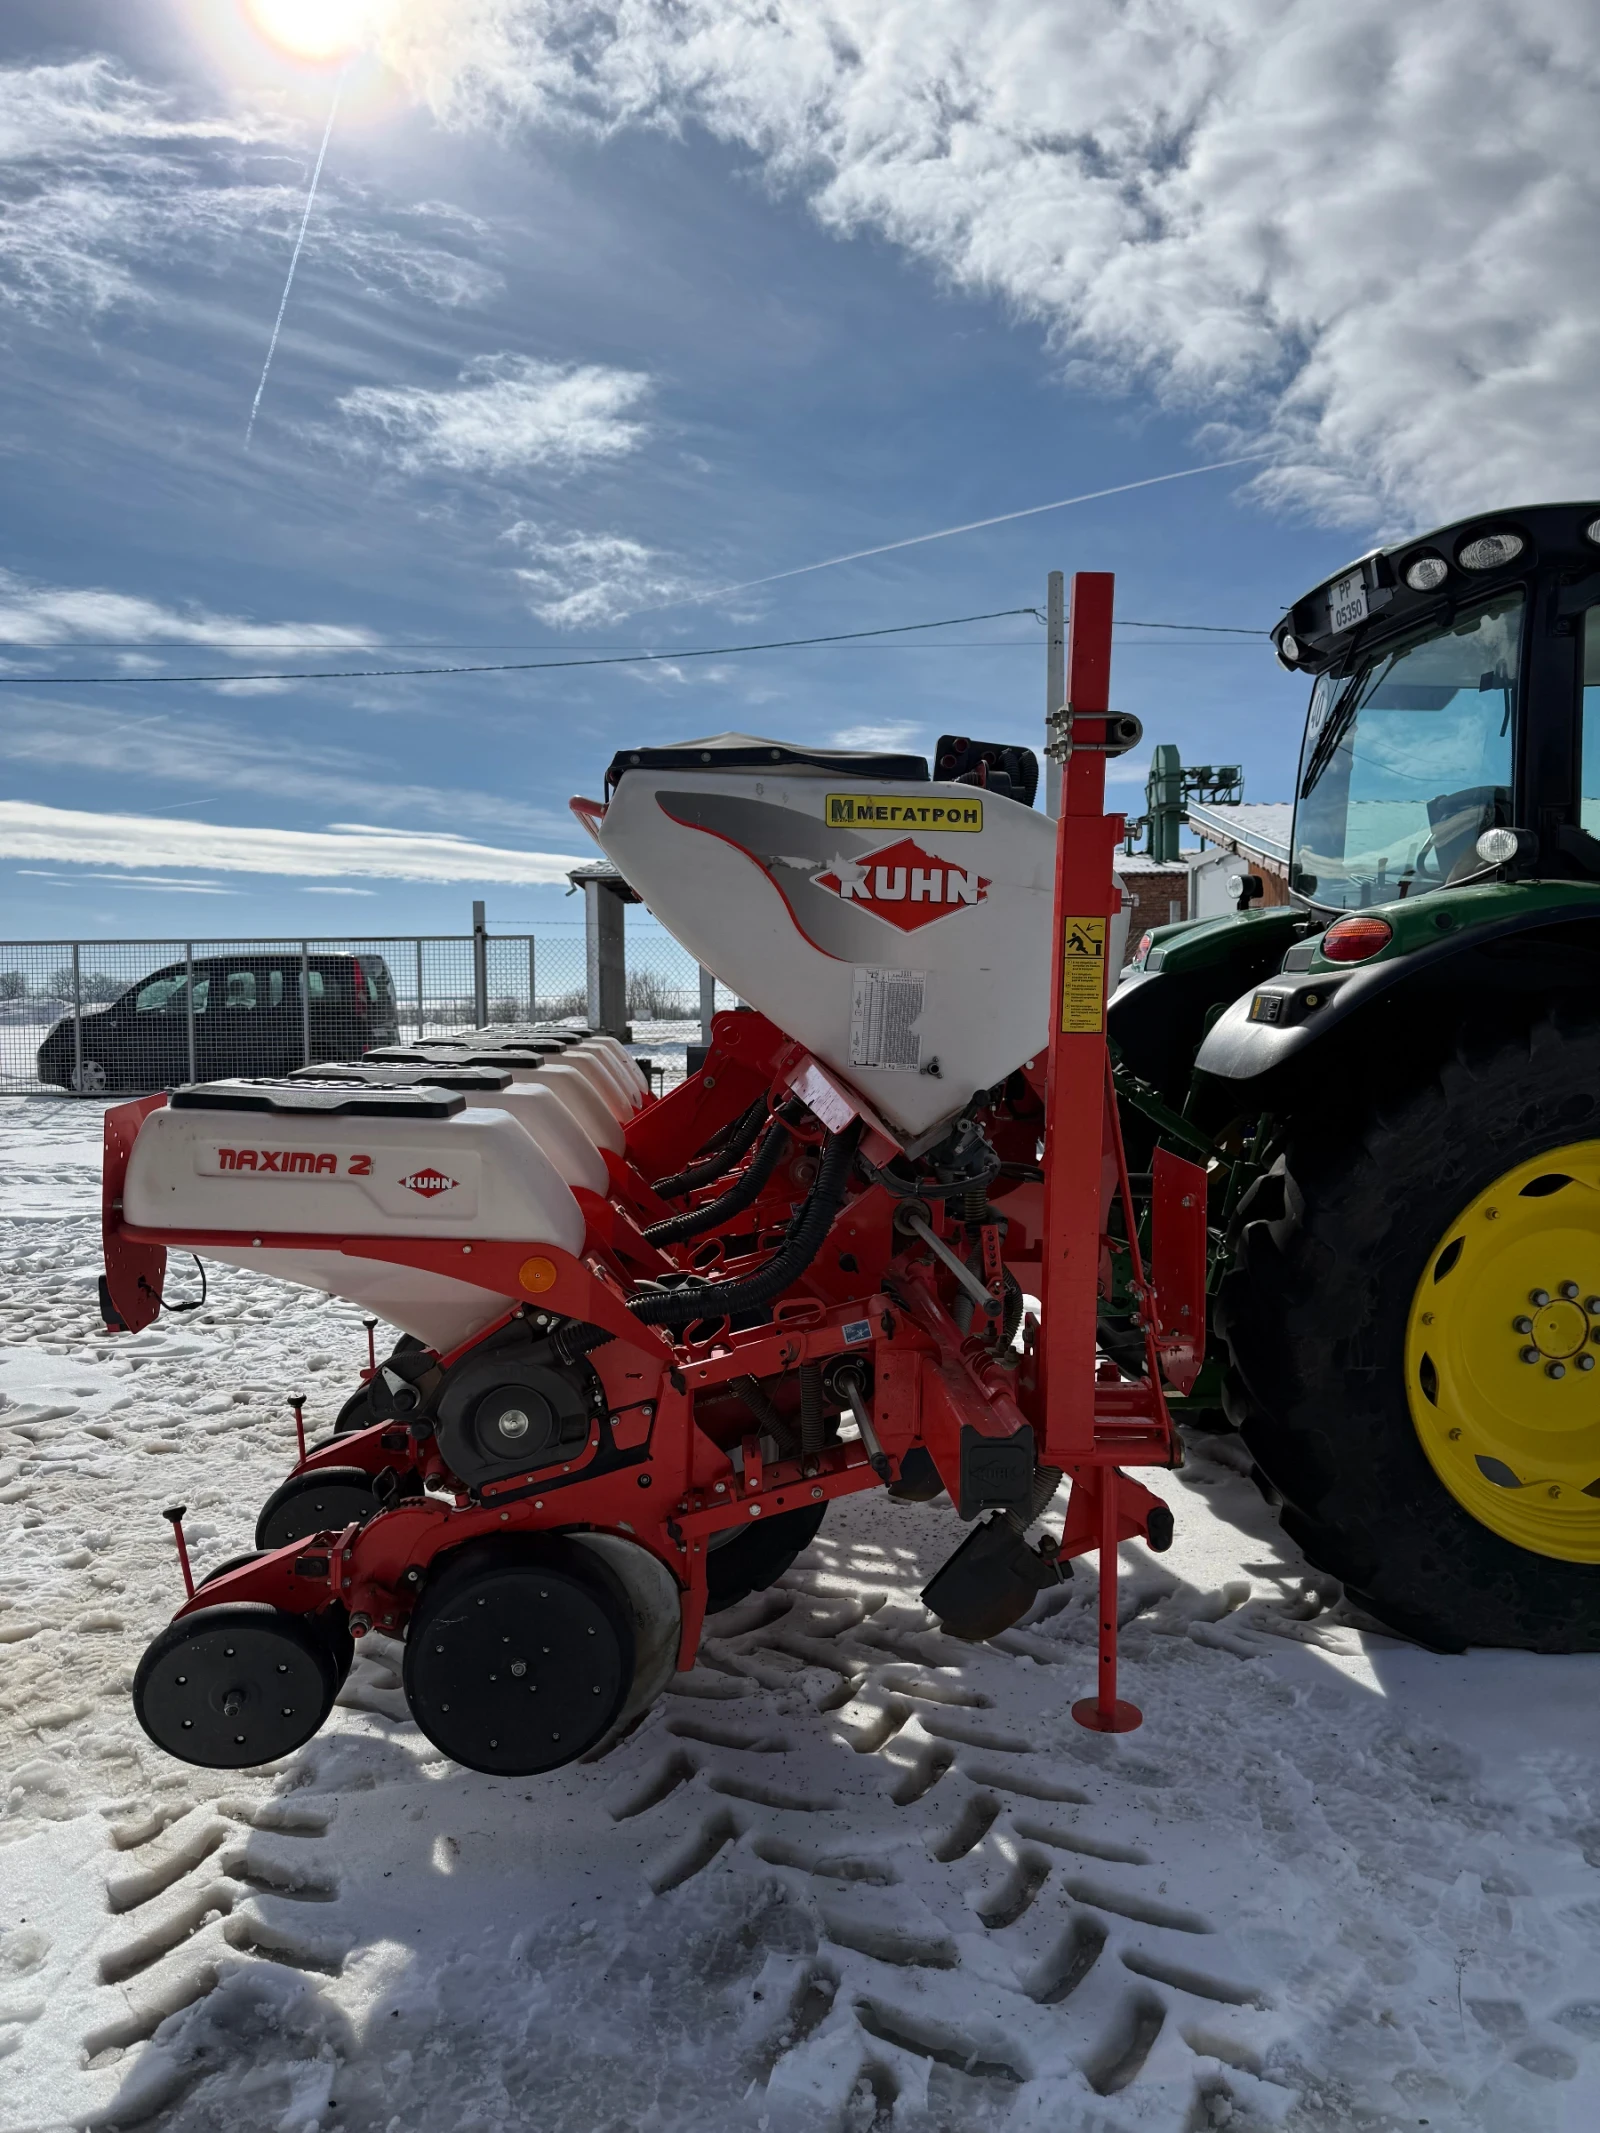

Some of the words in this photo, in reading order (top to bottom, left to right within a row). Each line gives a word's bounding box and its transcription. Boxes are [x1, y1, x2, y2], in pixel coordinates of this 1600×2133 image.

[1338, 579, 1351, 602] PP
[1336, 598, 1363, 627] 05350
[1310, 690, 1325, 729] 40
[857, 805, 978, 824] МЕГАТРОН
[839, 865, 980, 905] KUHN
[347, 1153, 373, 1176] 2
[405, 1176, 454, 1189] KUHN
